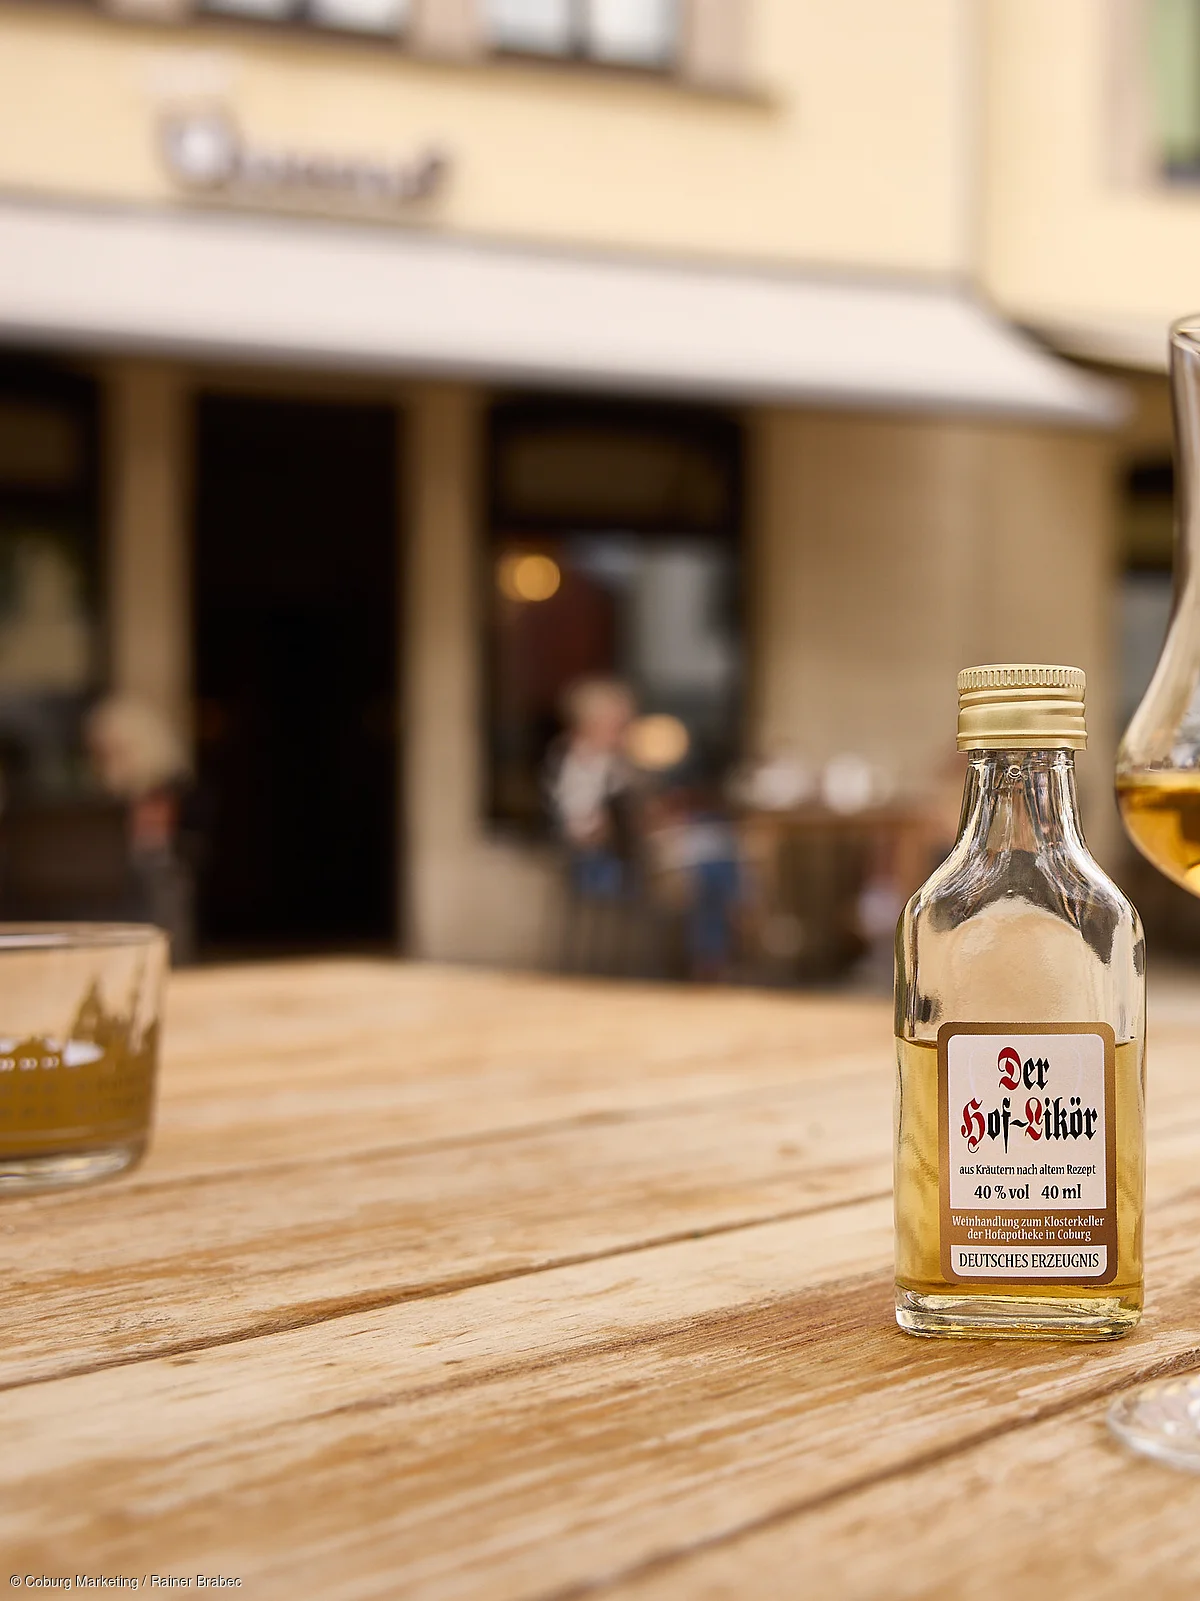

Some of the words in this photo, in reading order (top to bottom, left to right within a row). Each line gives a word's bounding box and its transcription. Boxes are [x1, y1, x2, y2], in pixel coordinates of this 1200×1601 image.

[998, 1046, 1049, 1091] Der
[960, 1165, 974, 1175] aus
[976, 1165, 1015, 1175] Kräutern
[1017, 1164, 1038, 1175] nach
[1040, 1164, 1064, 1175] altem
[1067, 1165, 1096, 1177] Rezept
[974, 1186, 991, 1199] 40
[1009, 1184, 1029, 1199] vol
[1041, 1186, 1058, 1199] 40
[1063, 1184, 1081, 1199] ml
[952, 1216, 1019, 1229] Weinhandlung
[1021, 1218, 1042, 1227] zum
[1044, 1216, 1104, 1227] Klosterkeller
[968, 1229, 983, 1239] der
[985, 1230, 1043, 1242] Hofapotheke
[1046, 1230, 1055, 1239] in
[1057, 1230, 1091, 1241] Coburg
[960, 1253, 1028, 1267] DEUTSCHES
[1032, 1253, 1099, 1268] ERZEUGNIS
